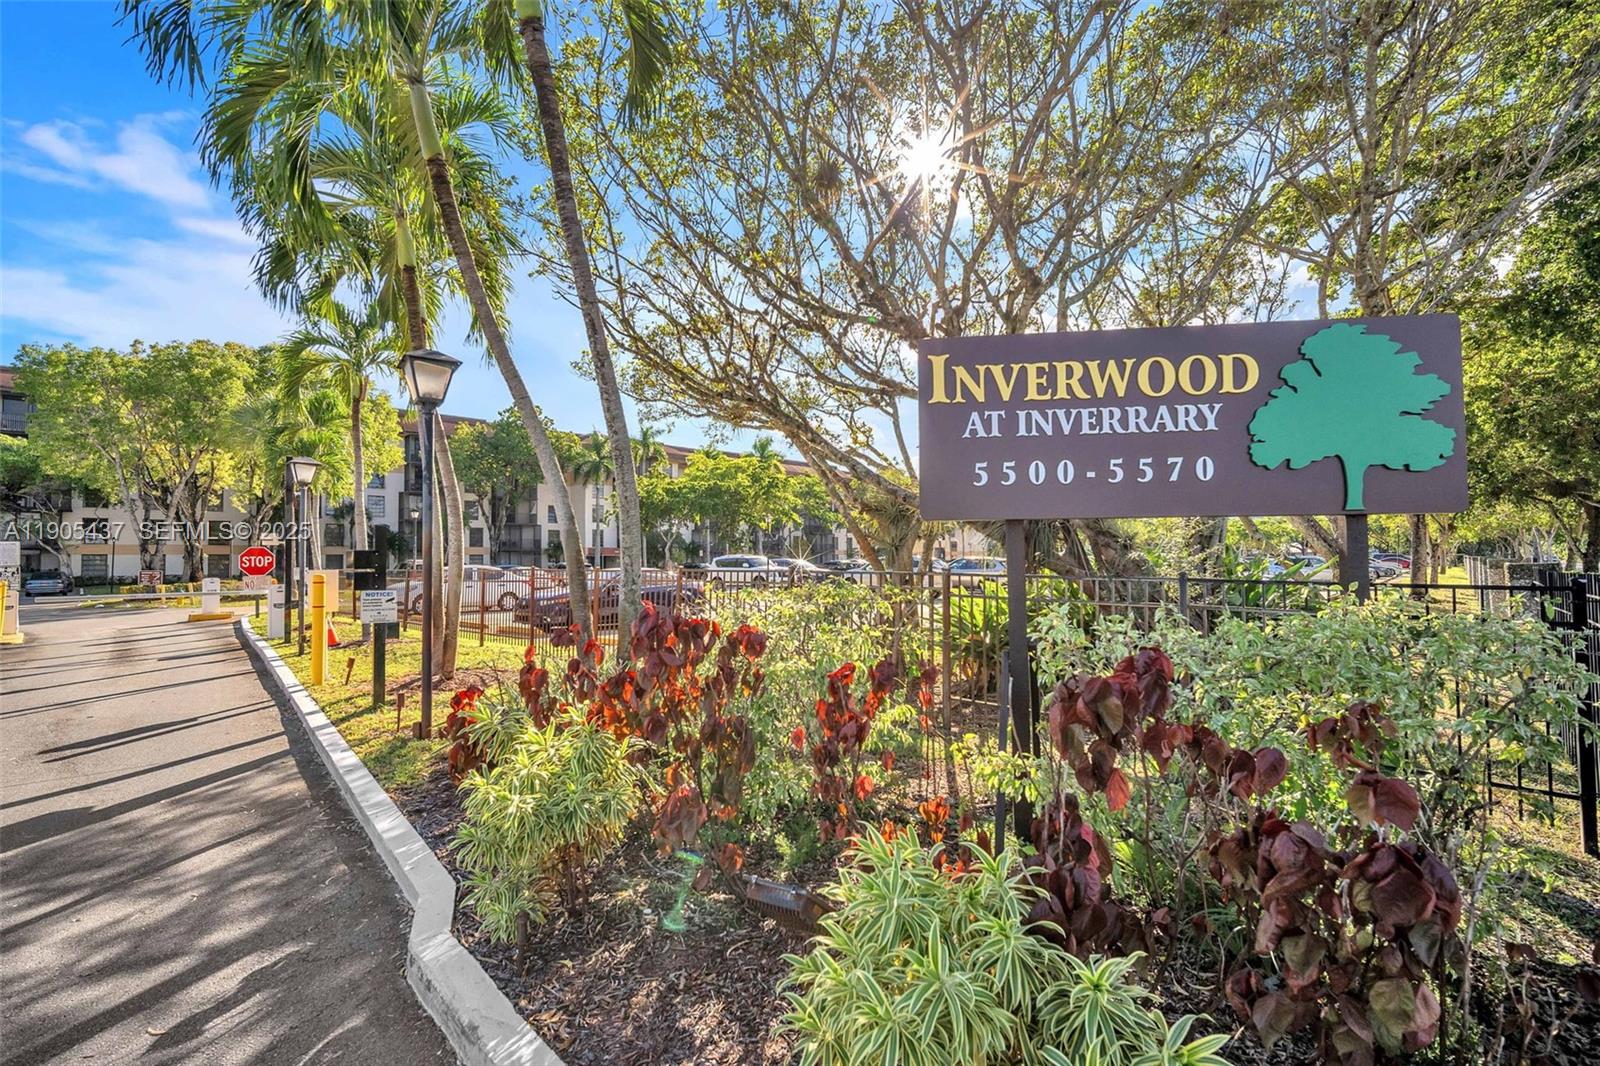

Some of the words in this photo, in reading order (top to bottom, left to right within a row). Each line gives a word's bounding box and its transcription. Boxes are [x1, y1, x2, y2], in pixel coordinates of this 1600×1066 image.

[927, 353, 1259, 404] INVERWOOD
[962, 410, 1005, 438] AT
[1015, 403, 1223, 437] INVERRARY
[241, 556, 272, 567] STOP
[244, 580, 255, 590] NO
